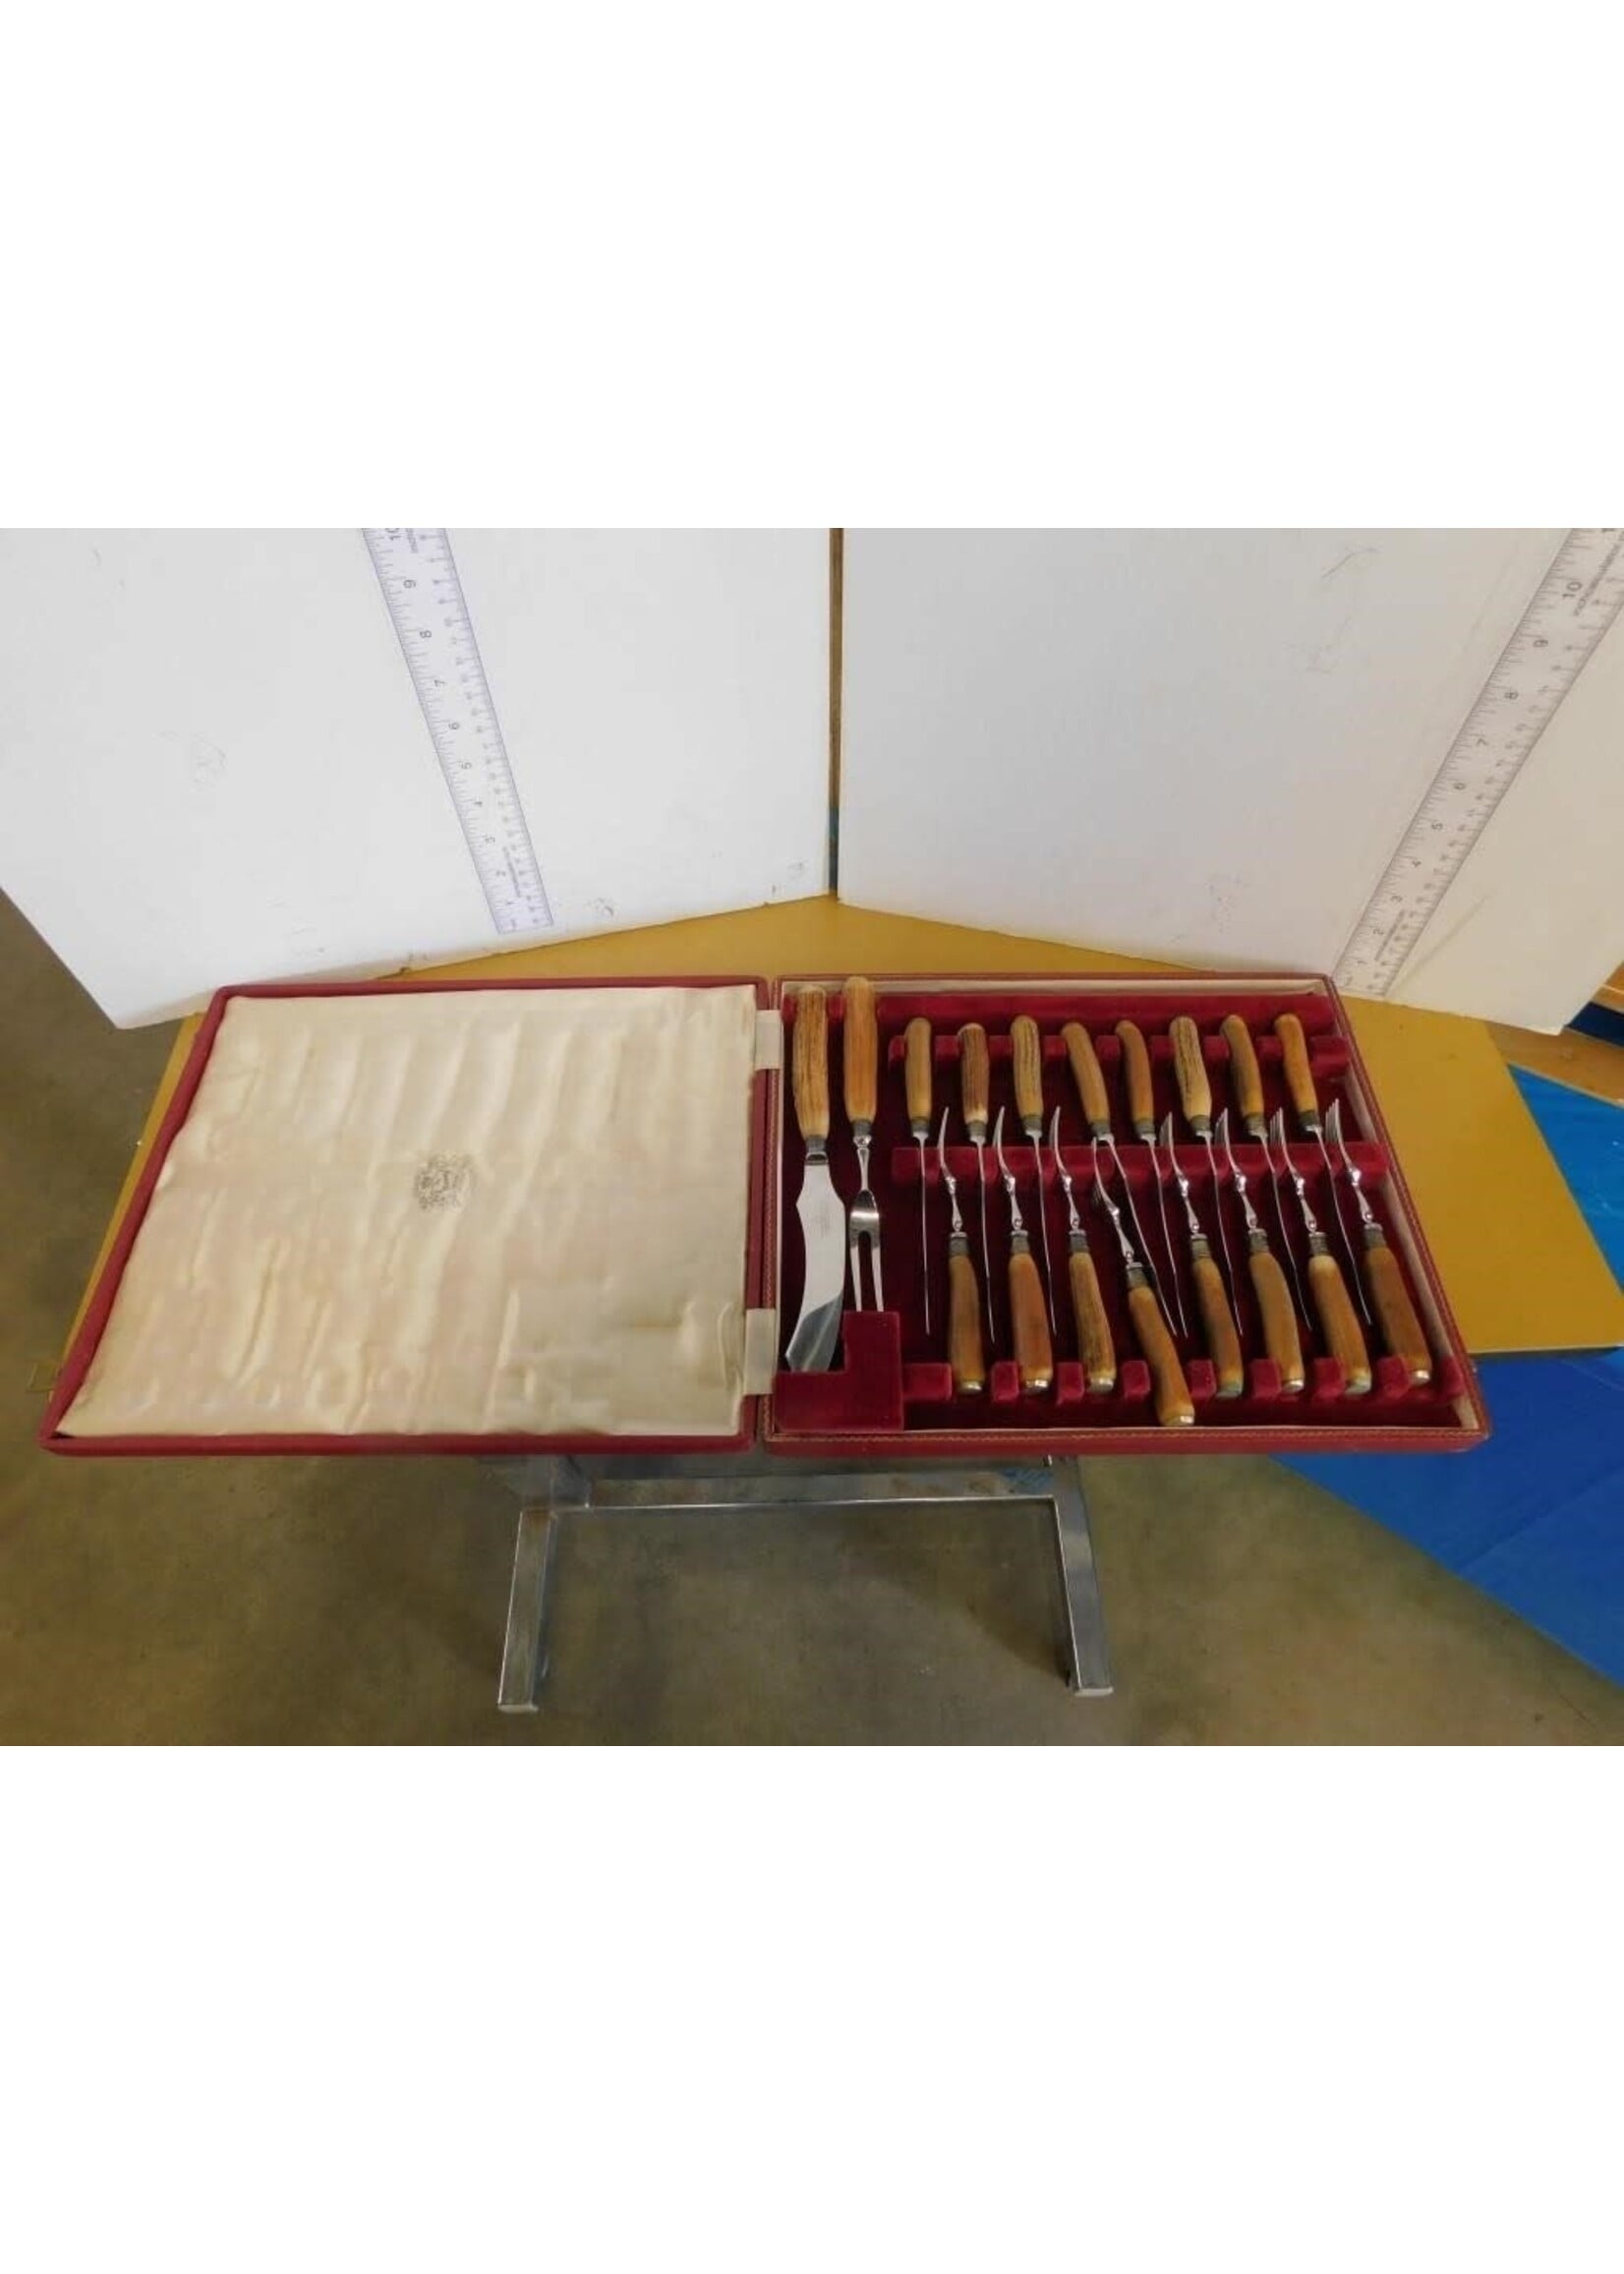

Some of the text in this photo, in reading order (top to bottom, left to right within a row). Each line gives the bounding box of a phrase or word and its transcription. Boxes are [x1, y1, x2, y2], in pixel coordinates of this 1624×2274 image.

[403, 580, 416, 589] 9
[1563, 581, 1583, 599] 10
[420, 630, 432, 639] 8
[1534, 639, 1548, 648] 9
[1504, 690, 1519, 700] 8
[448, 722, 460, 730] 6
[1478, 738, 1488, 747] 7
[1431, 822, 1443, 831] 5
[1412, 858, 1421, 868] 4
